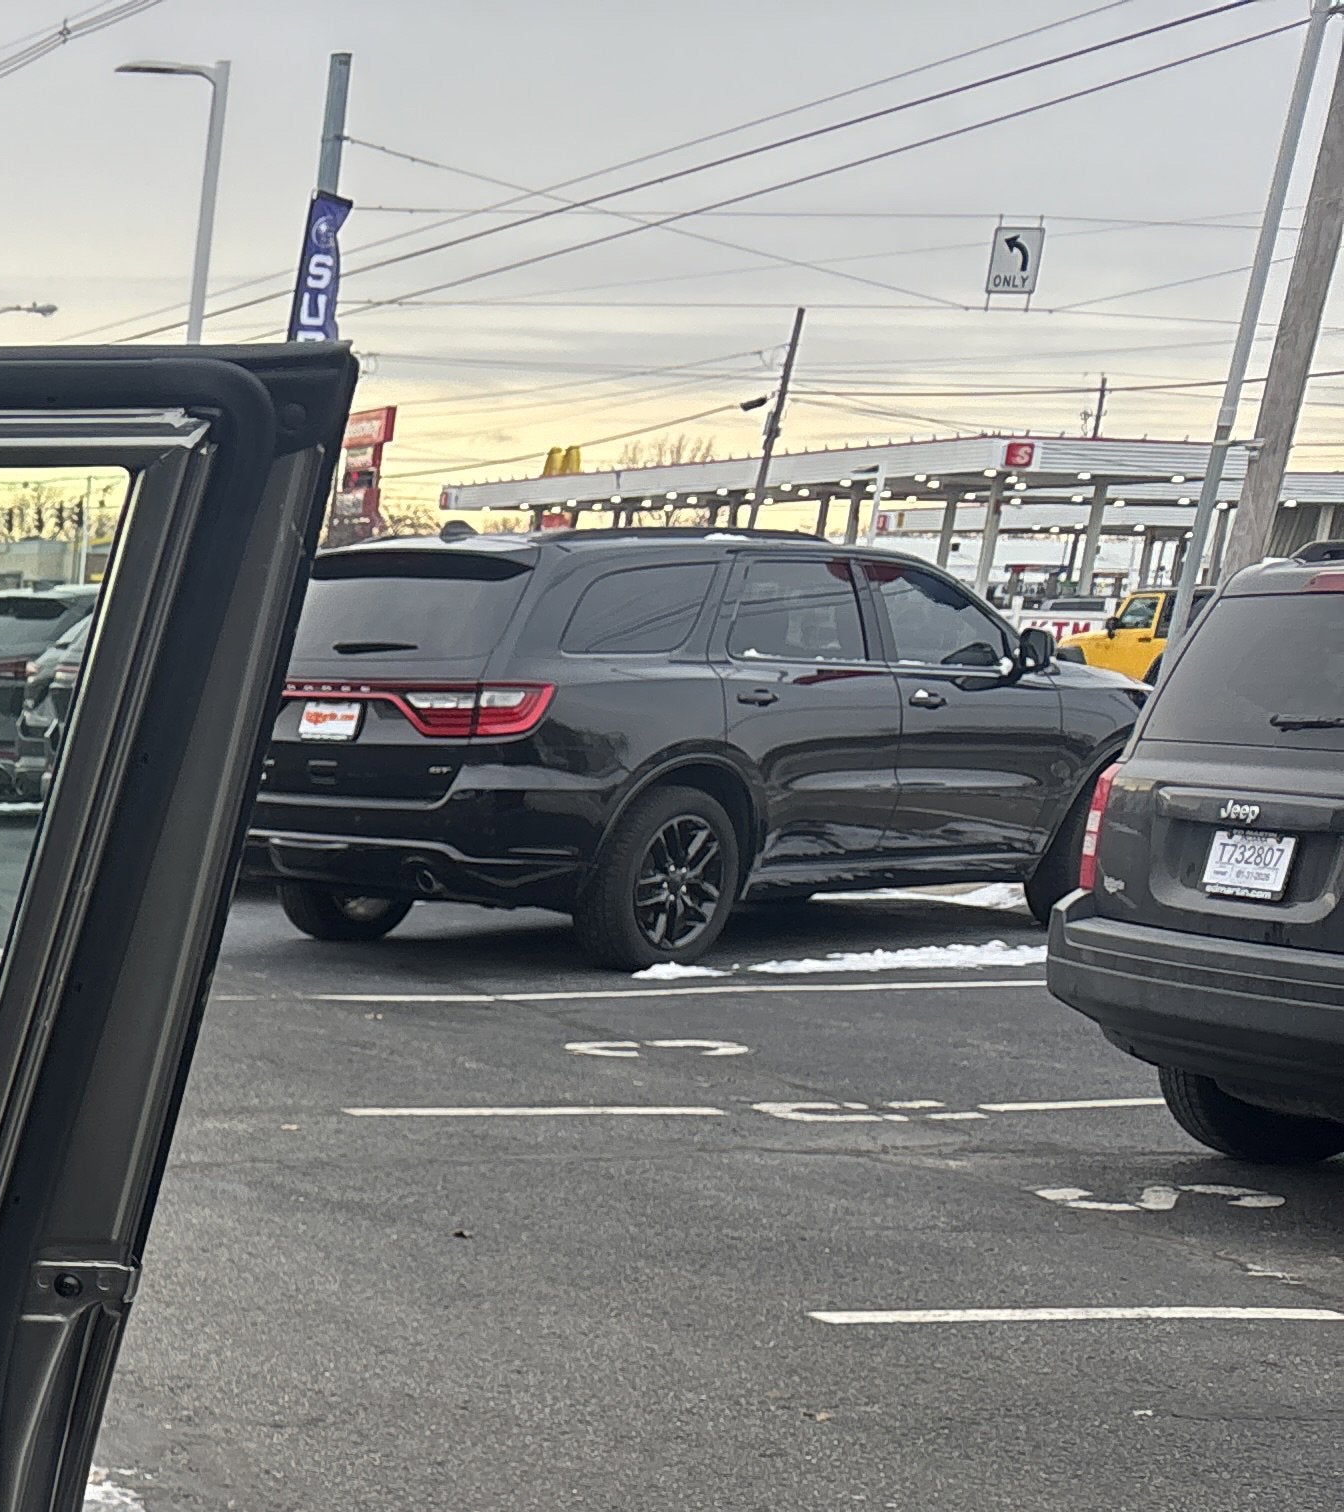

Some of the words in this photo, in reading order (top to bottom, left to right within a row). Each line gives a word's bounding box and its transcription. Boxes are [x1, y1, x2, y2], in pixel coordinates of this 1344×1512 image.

[993, 275, 1029, 288] ONLY
[1220, 799, 1260, 824] Jeep
[1218, 842, 1285, 867] T732807
